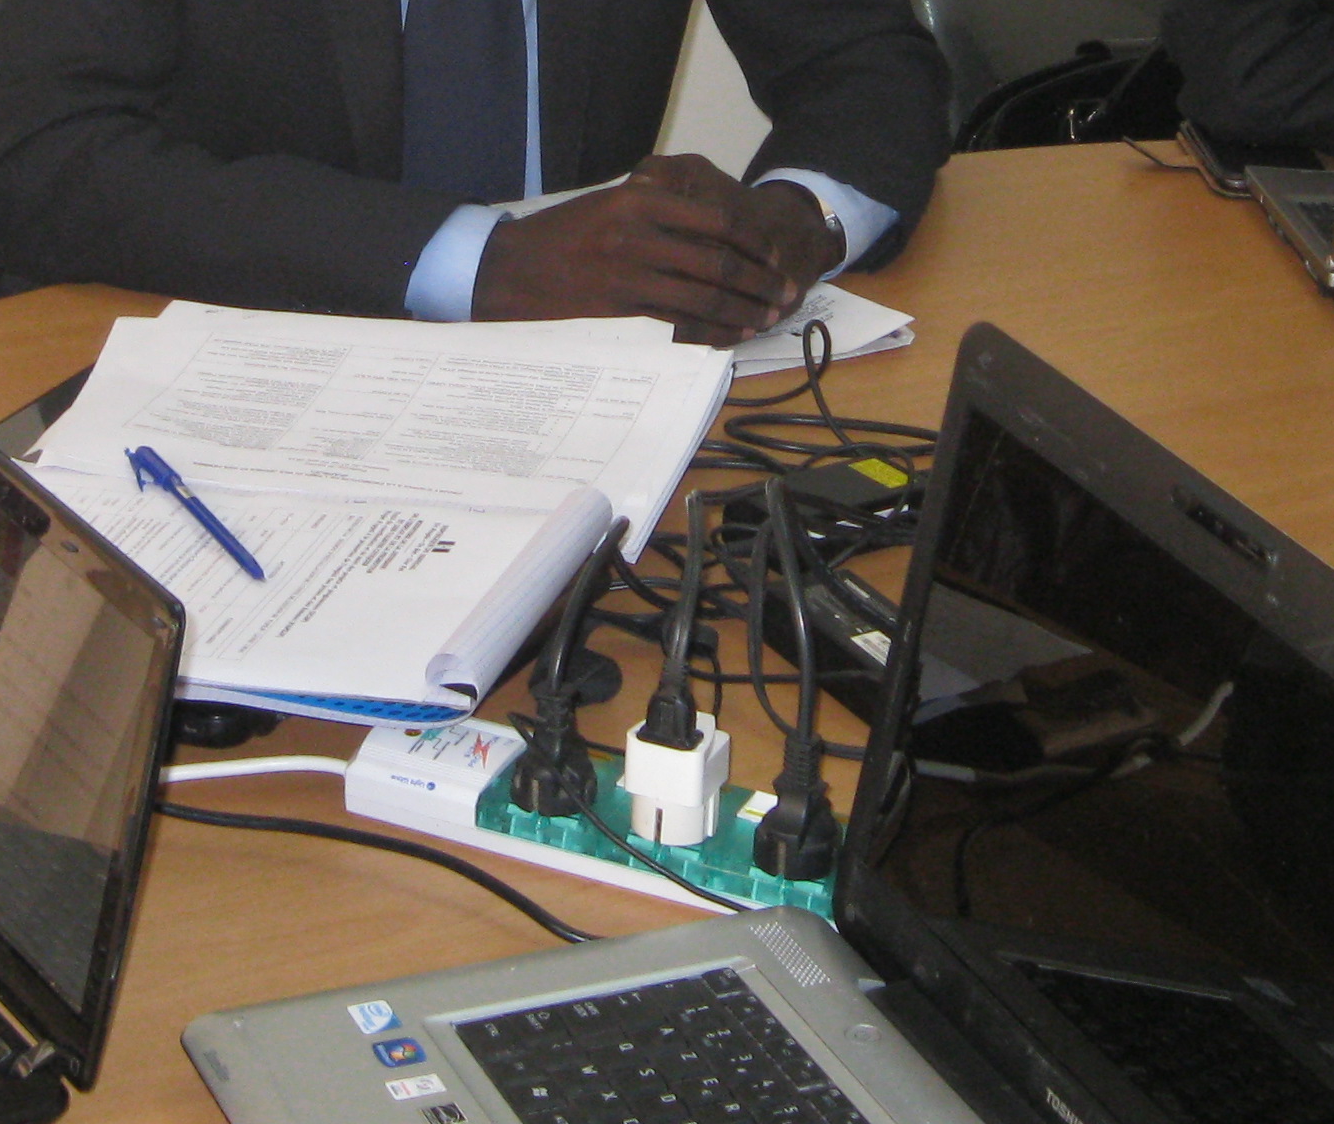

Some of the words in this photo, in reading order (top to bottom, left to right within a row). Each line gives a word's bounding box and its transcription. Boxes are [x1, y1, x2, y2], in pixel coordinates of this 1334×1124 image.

[659, 1027, 675, 1036] A
[618, 1042, 634, 1052] Q
[680, 1051, 698, 1061] Z
[738, 1053, 753, 1062] 3
[581, 1065, 598, 1075] W
[639, 1067, 656, 1077] S
[702, 1077, 719, 1087] E
[601, 1091, 618, 1101] X
[660, 1093, 677, 1103] D
[724, 1103, 741, 1113] R
[783, 1105, 799, 1114] 5
